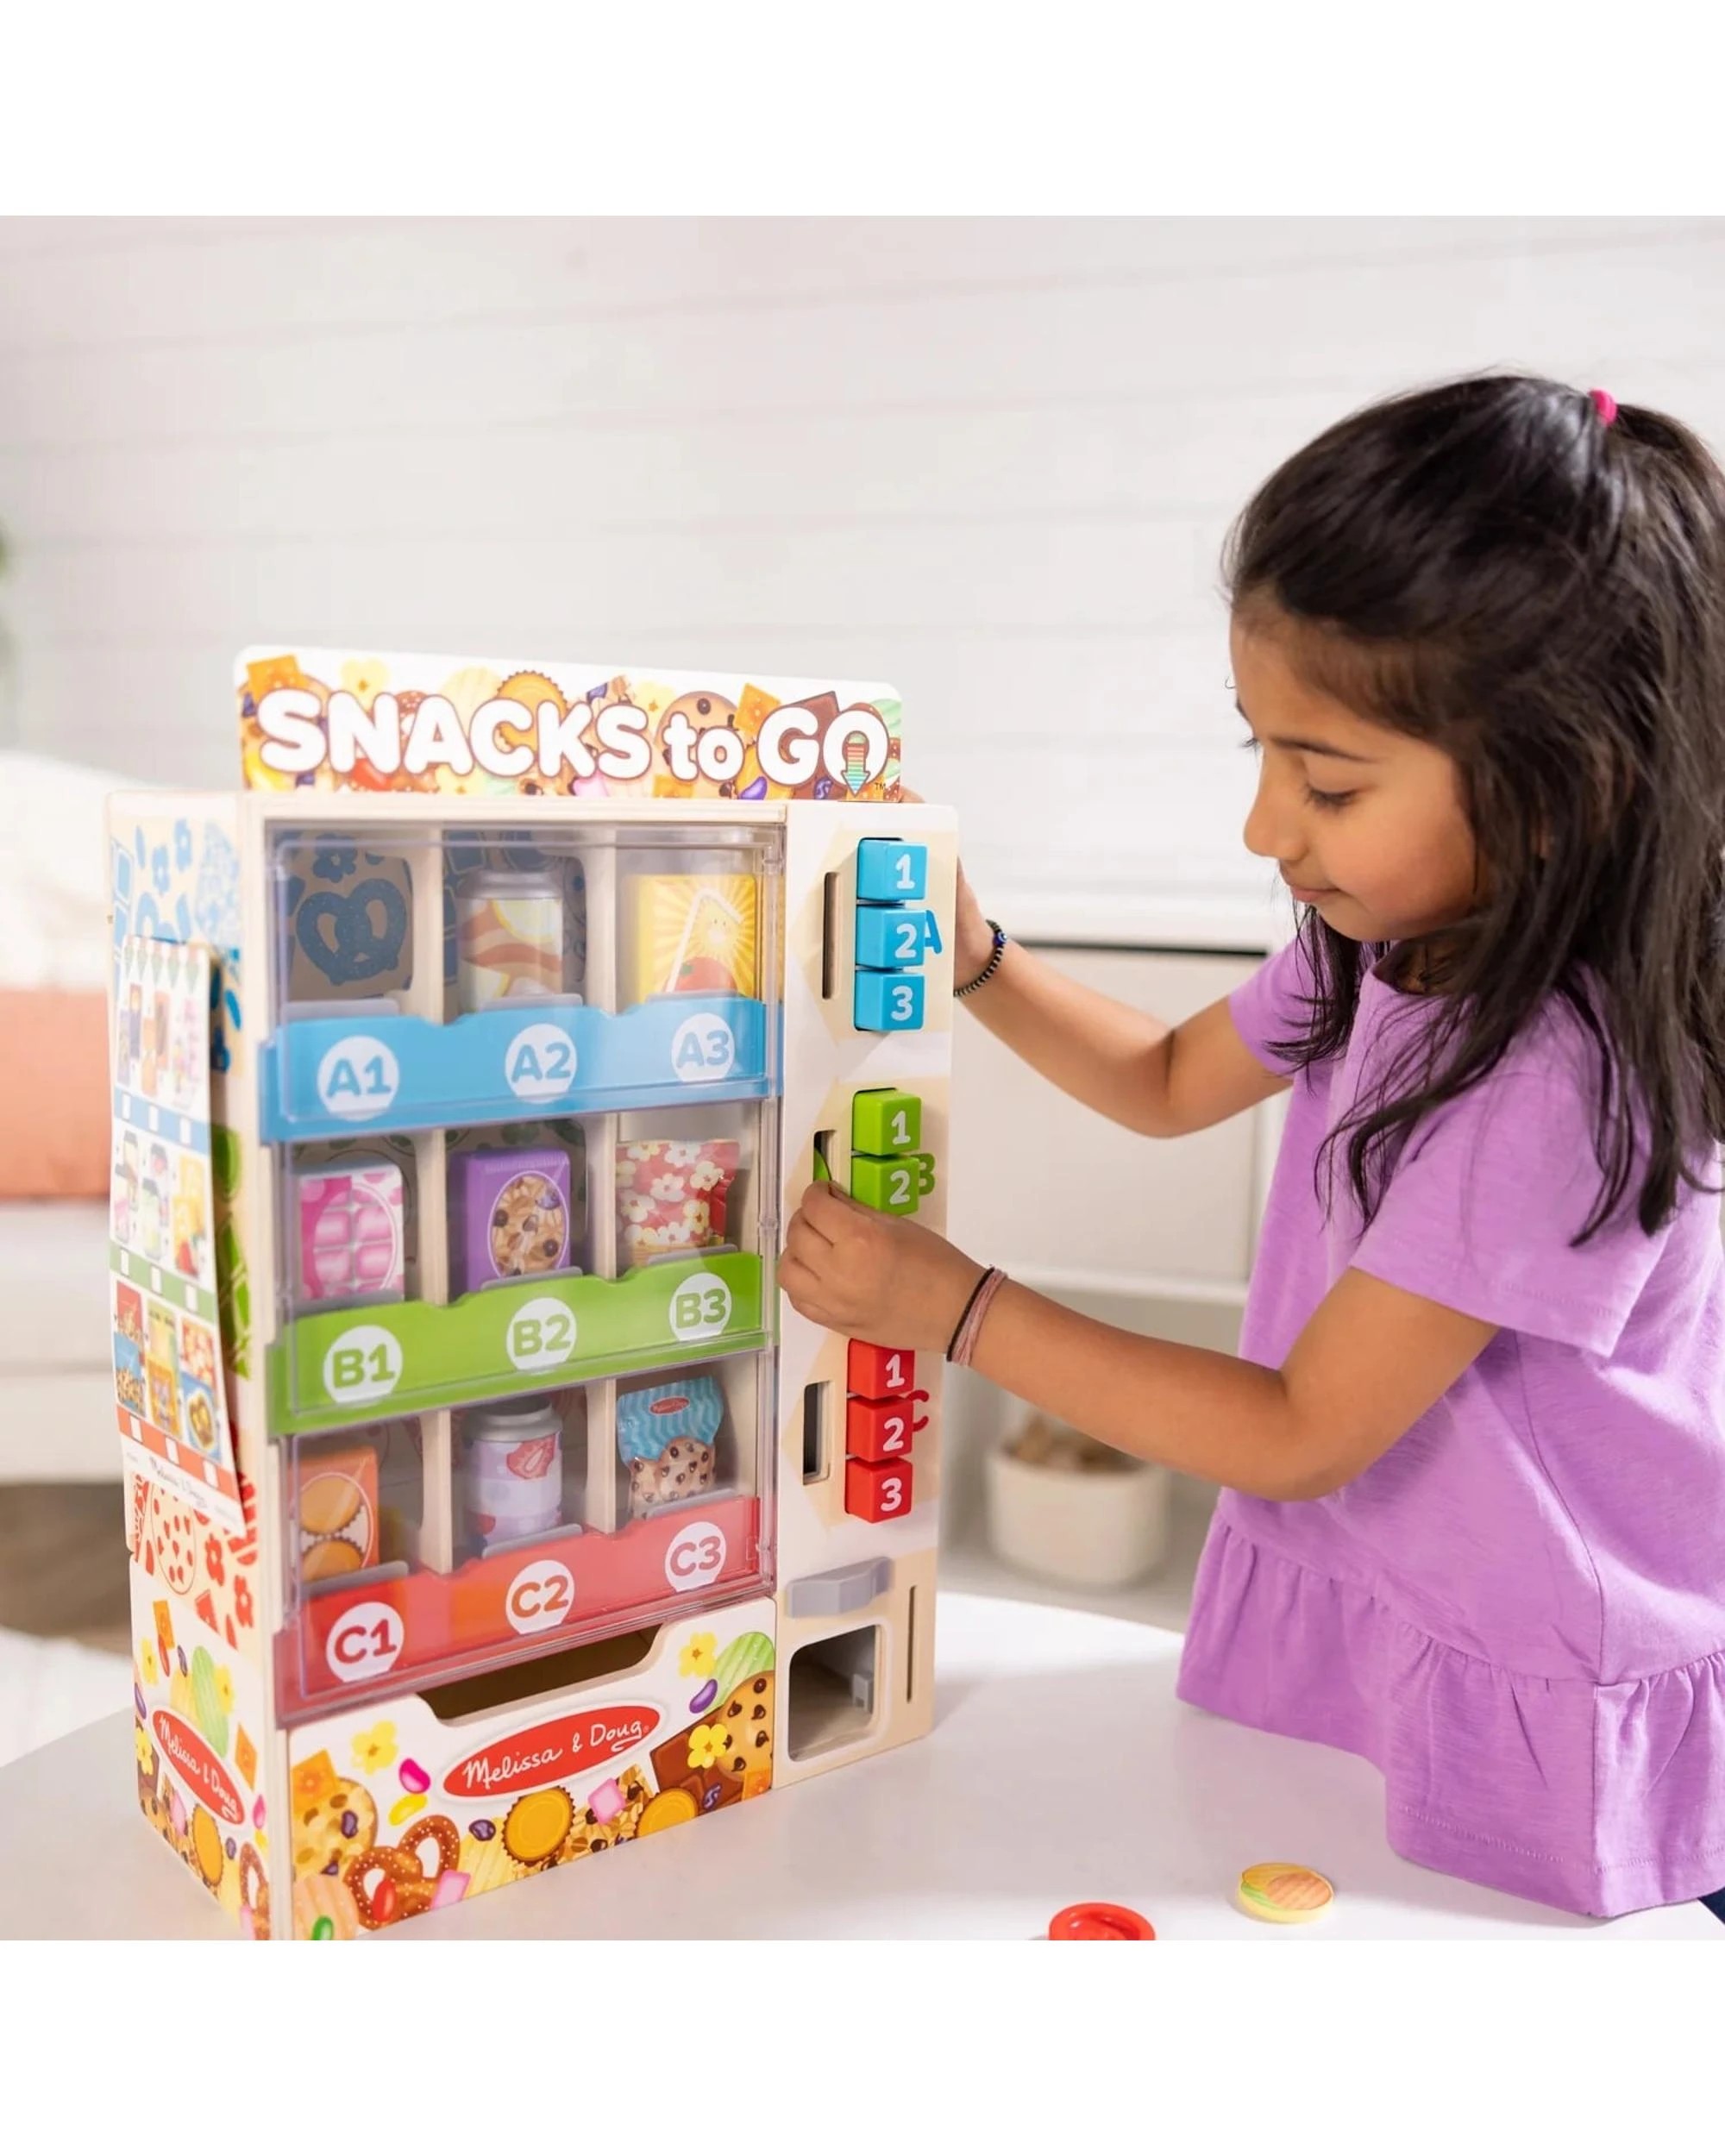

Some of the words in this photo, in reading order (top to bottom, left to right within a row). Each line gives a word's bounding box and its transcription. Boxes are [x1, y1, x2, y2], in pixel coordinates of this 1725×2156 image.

[258, 688, 652, 781] SNACKS
[662, 711, 745, 781] to
[756, 705, 888, 787] GO
[895, 854, 915, 889] 1
[895, 924, 917, 959] 2
[891, 986, 913, 1021] 3
[511, 1041, 572, 1084] A2
[675, 1028, 730, 1069] A3
[325, 1056, 392, 1099] A1
[891, 1110, 911, 1145] 1
[889, 1169, 911, 1205] 2
[675, 1288, 726, 1329] B3
[512, 1313, 571, 1357] B2
[332, 1343, 396, 1390] B1
[886, 1354, 905, 1388] 1
[883, 1417, 904, 1451] 2
[881, 1477, 902, 1512] 3
[670, 1535, 721, 1576] C3
[511, 1574, 569, 1619] C2
[333, 1619, 398, 1664] C1
[159, 1714, 201, 1776] Melissa
[210, 1768, 238, 1821] Doug
[462, 1742, 563, 1790] Melissa
[572, 1733, 584, 1753] &
